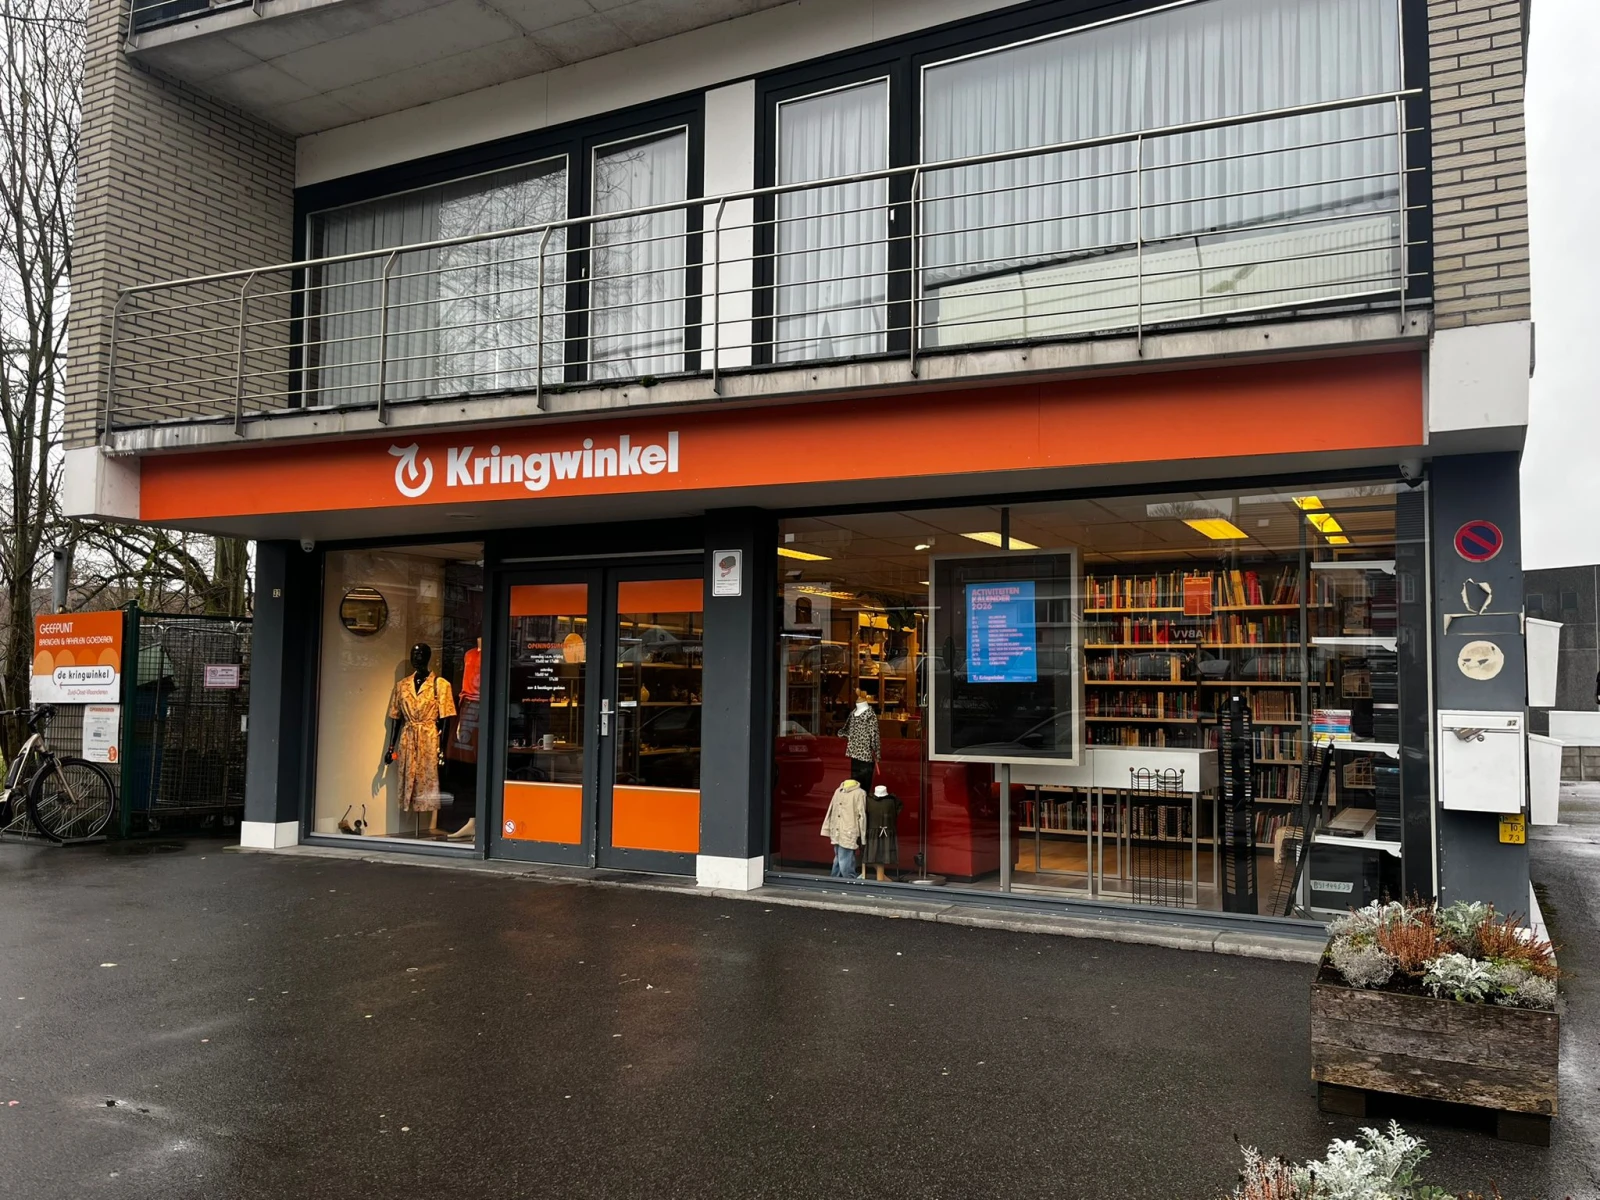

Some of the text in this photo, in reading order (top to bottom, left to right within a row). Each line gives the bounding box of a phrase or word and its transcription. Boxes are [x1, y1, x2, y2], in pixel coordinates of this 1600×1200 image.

[446, 431, 679, 491] Kringwinkel
[972, 587, 1019, 596] ACTIVITEITEN
[972, 595, 1010, 603] KALENDER
[972, 602, 992, 610] 2026
[39, 622, 73, 634] GEEFPUNT
[38, 635, 113, 647] BRENGEN & AFHALEN GOEDEREN
[57, 669, 110, 682] de kringwinkel
